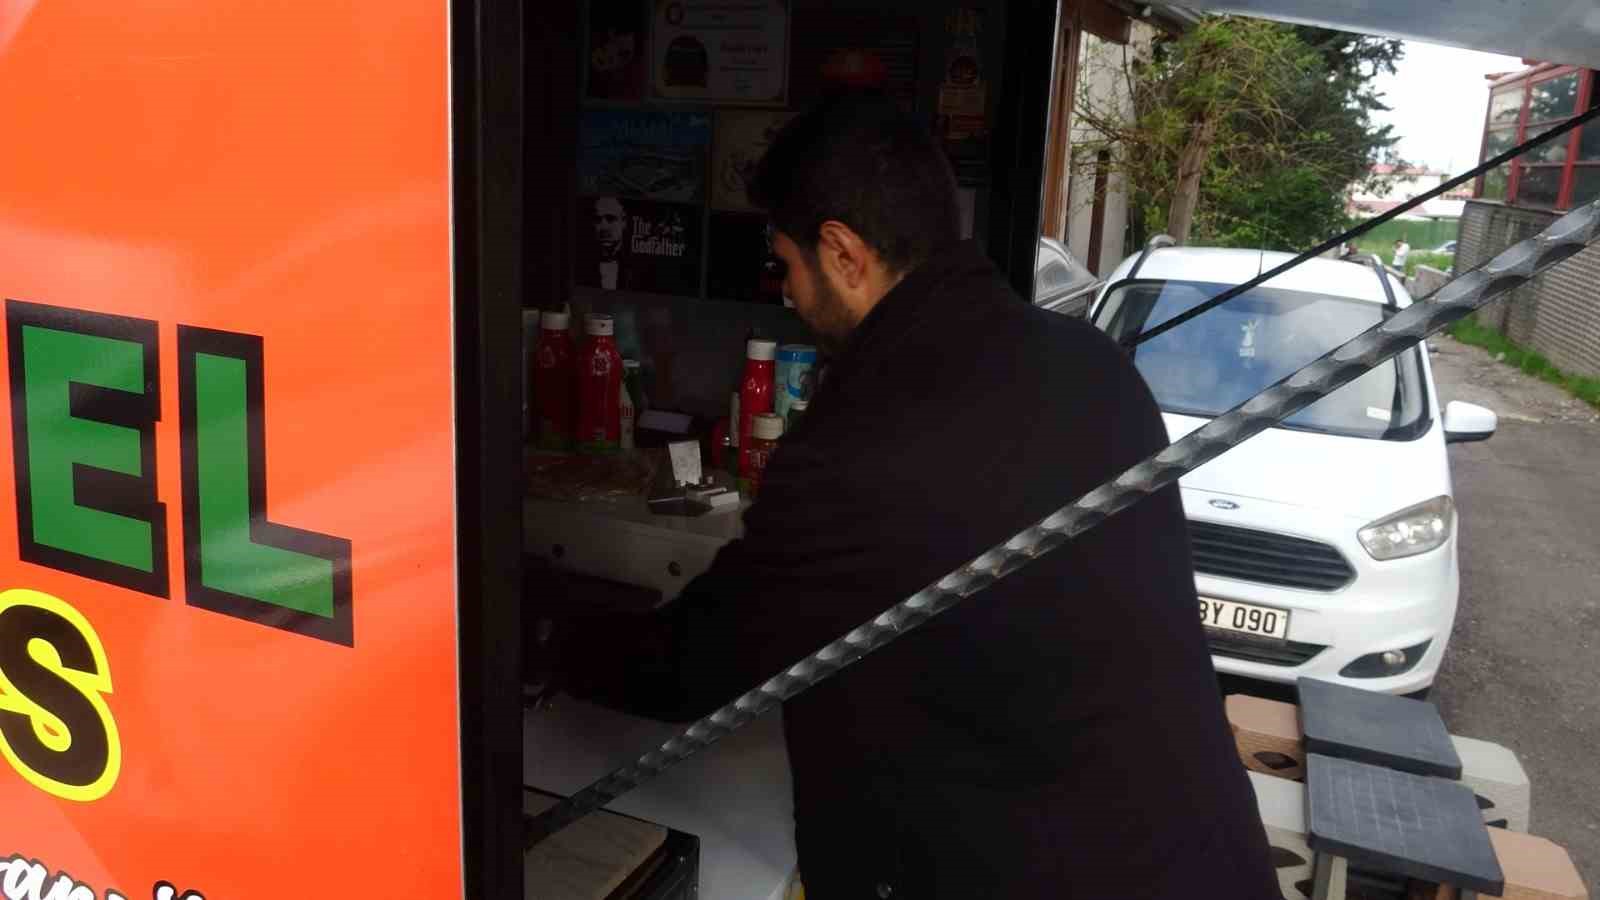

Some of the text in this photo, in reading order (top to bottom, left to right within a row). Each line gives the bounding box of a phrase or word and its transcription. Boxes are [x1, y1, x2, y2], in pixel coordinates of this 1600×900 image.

[631, 215, 650, 235] The
[5, 299, 355, 648] EL
[1231, 606, 1277, 634] 090
